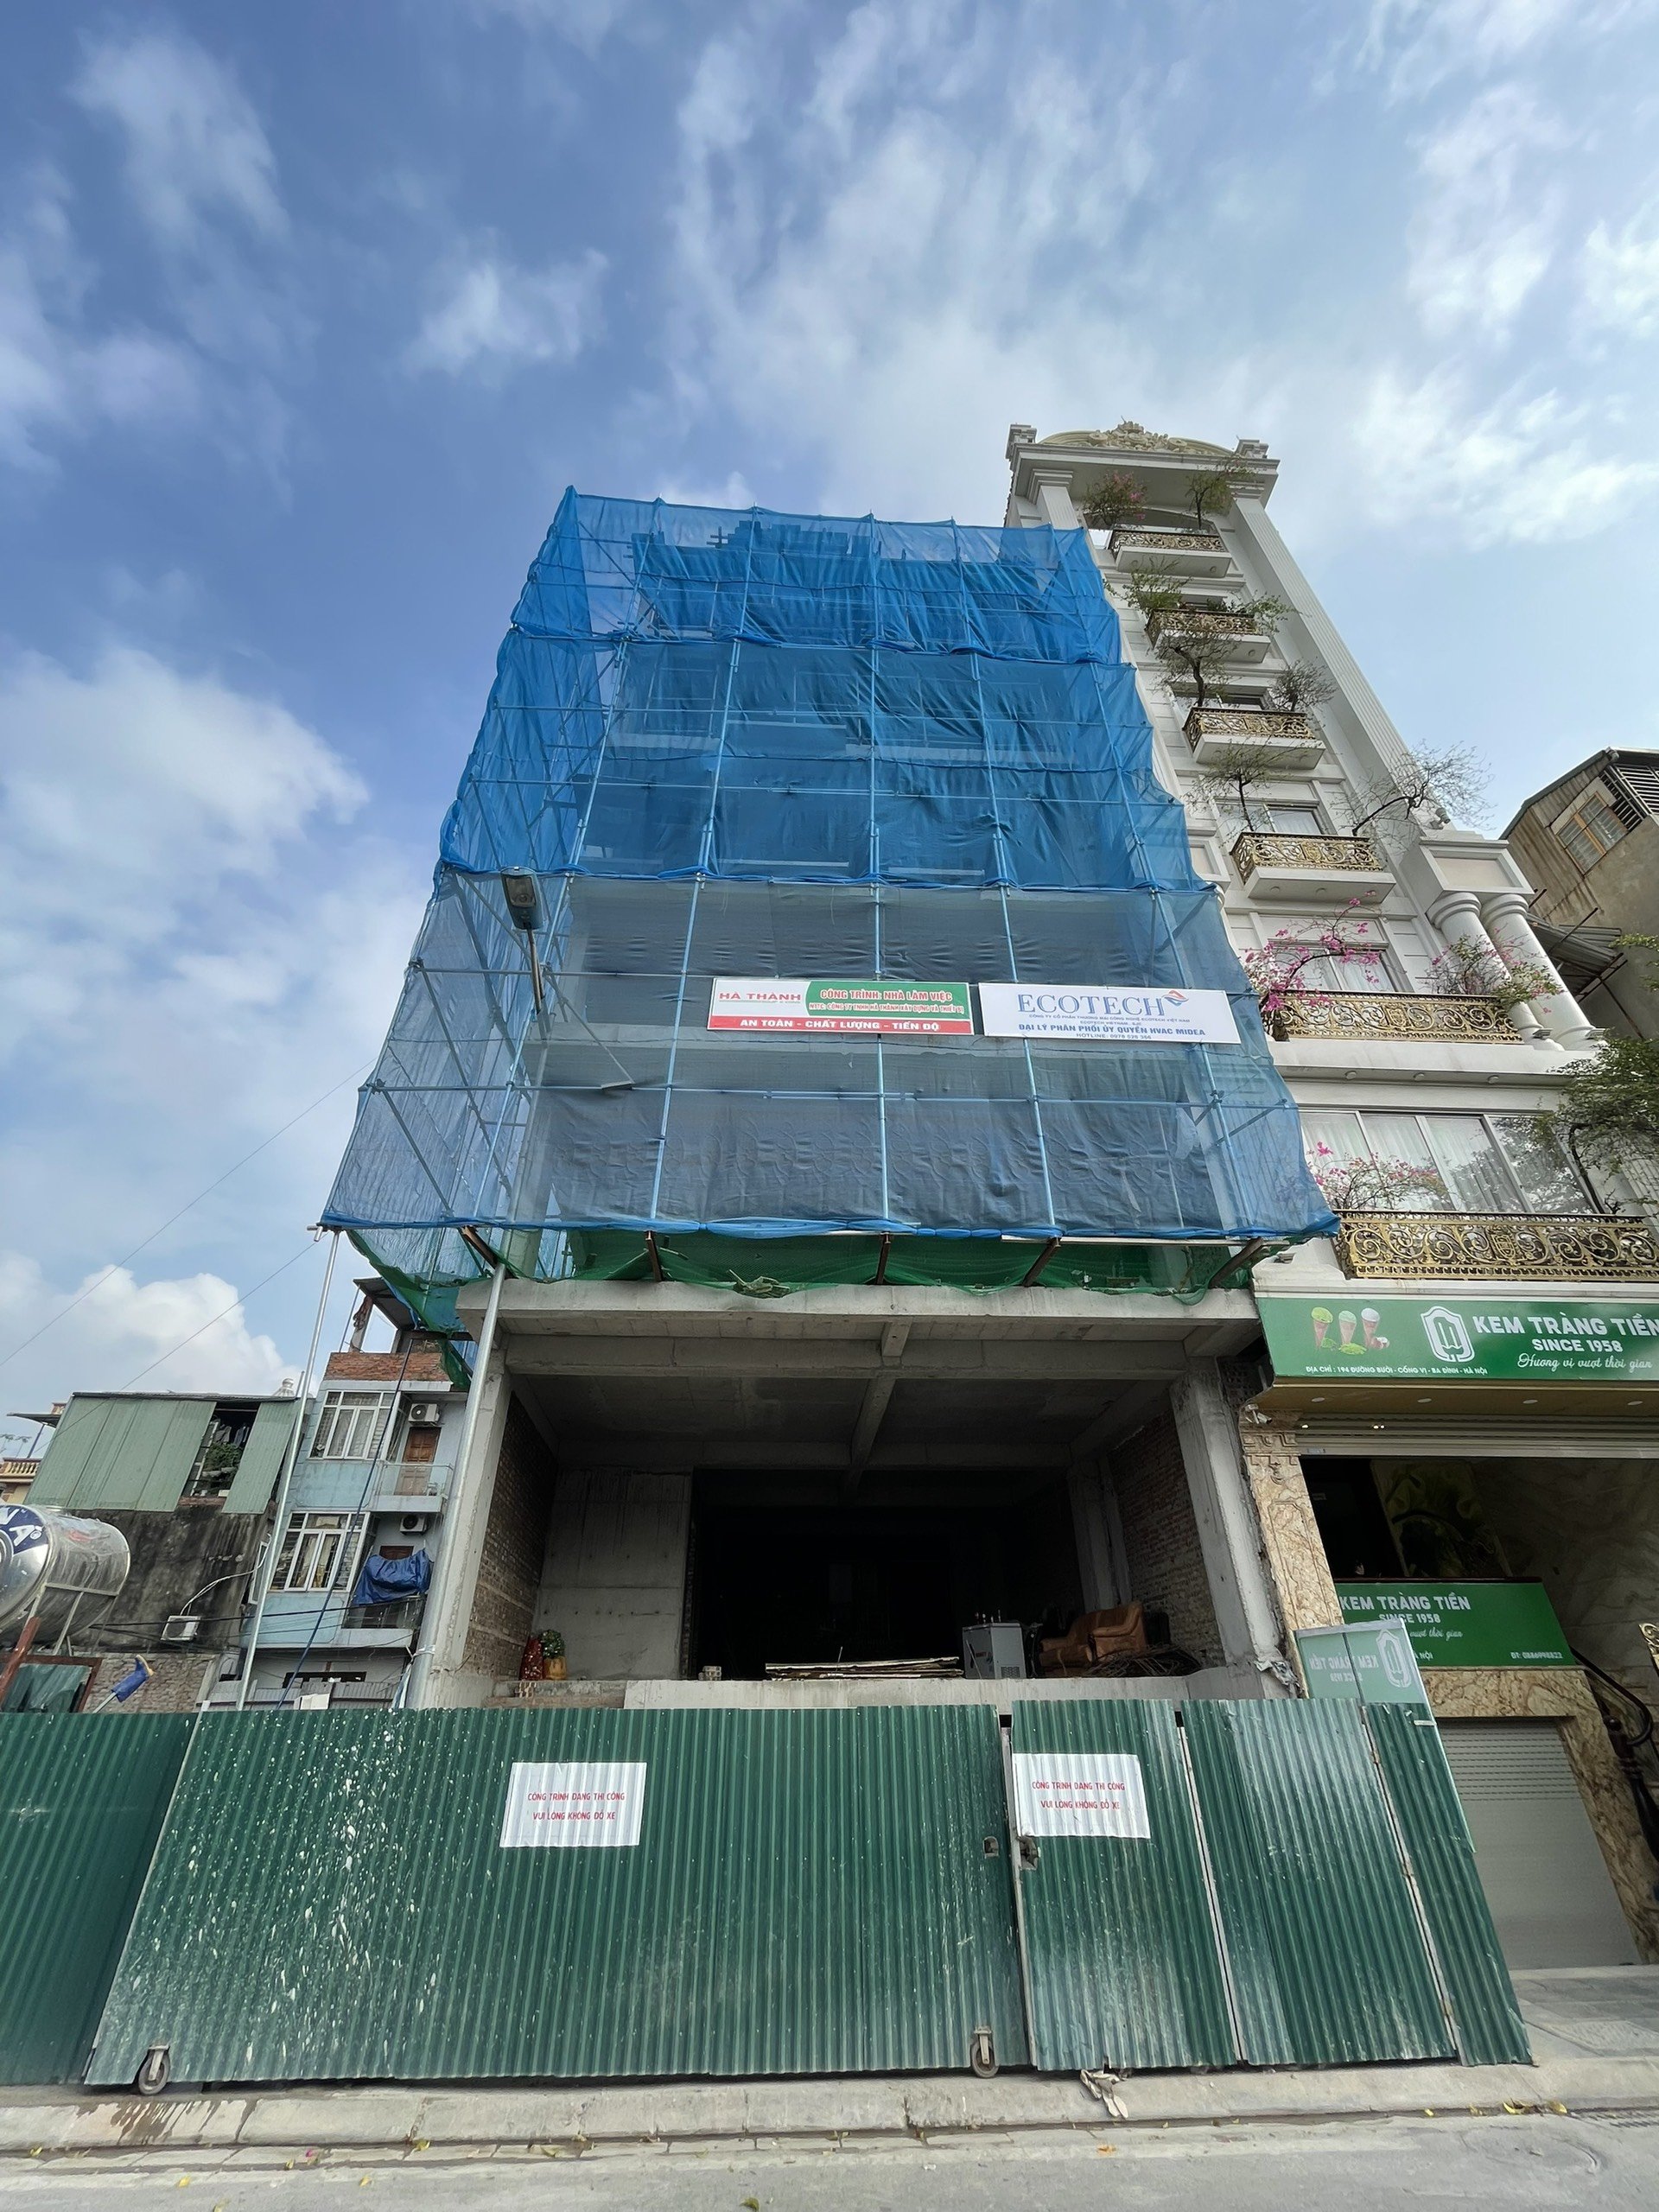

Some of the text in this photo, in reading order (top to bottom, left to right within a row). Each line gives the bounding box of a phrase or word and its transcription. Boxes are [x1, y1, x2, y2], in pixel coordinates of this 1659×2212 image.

[821, 988, 848, 1000] CÔNG
[883, 990, 905, 1001] NHÀ
[906, 990, 928, 1001] LÀM
[930, 990, 952, 1003] VIỆC
[1018, 994, 1166, 1016] ECOTECH
[805, 1019, 836, 1027] CHẤT
[840, 1020, 880, 1030] LƯỢNG
[892, 1020, 919, 1030] TIẾN
[923, 1022, 939, 1032] ĐỘ
[1472, 1312, 1659, 1336] KEM TRÀNG TIỀN
[1532, 1339, 1624, 1352] SINCE 1958
[1474, 1367, 1488, 1376] NỘI
[1563, 1357, 1574, 1369] vị
[1630, 1358, 1653, 1373] gian
[1339, 1592, 1471, 1610] KEM TRÀNG TIỀN
[1416, 1614, 1441, 1624] 1958
